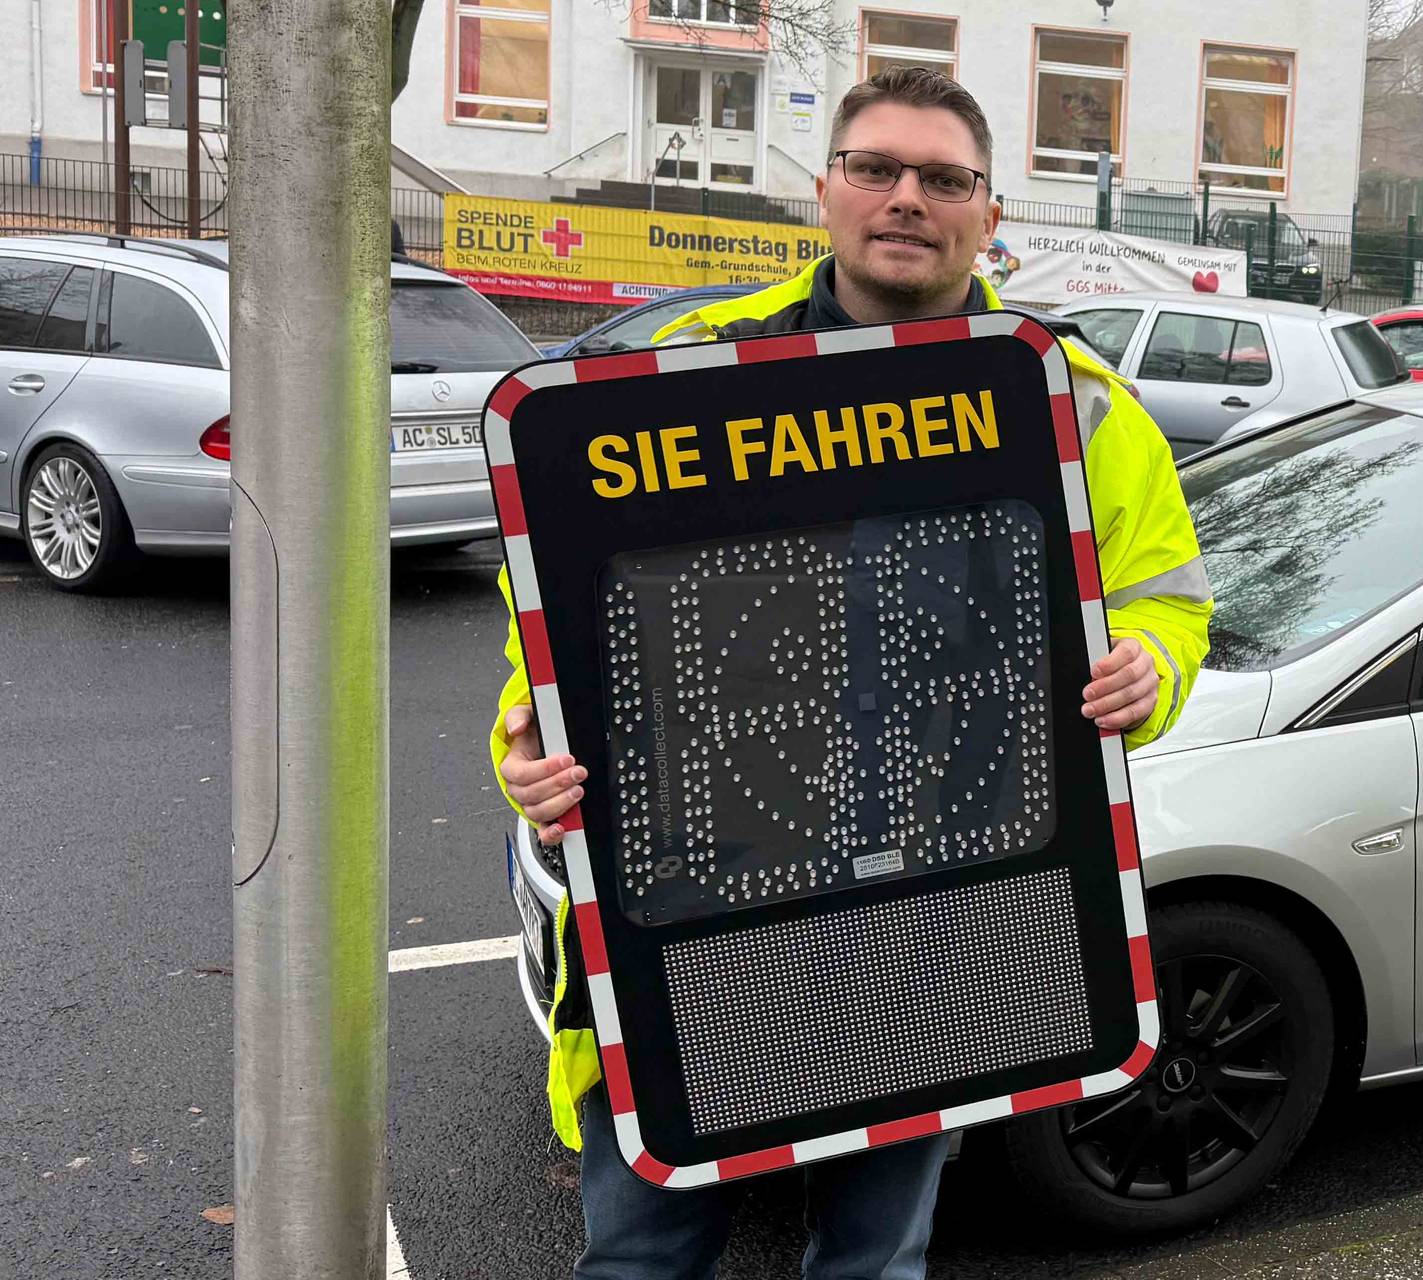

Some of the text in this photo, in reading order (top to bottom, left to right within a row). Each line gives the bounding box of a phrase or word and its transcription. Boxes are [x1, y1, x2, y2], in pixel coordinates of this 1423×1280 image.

[457, 209, 535, 229] SPENDE
[456, 227, 535, 253] BLUT
[649, 225, 788, 262] Donnerstag
[1028, 237, 1166, 264] HERZLICH WILLKOMMEN
[456, 253, 583, 274] BEIM ROTEN KREUZ
[686, 258, 791, 276] Gem.-Grundschule,
[1082, 263, 1112, 273] in der
[1178, 256, 1237, 272] GEMEINSAM MIT
[1066, 279, 1090, 293] GGS
[403, 428, 425, 448] AC
[436, 427, 459, 446] SL
[587, 390, 1000, 499] SIE FAHREN
[652, 687, 673, 849] www.datacollect.com
